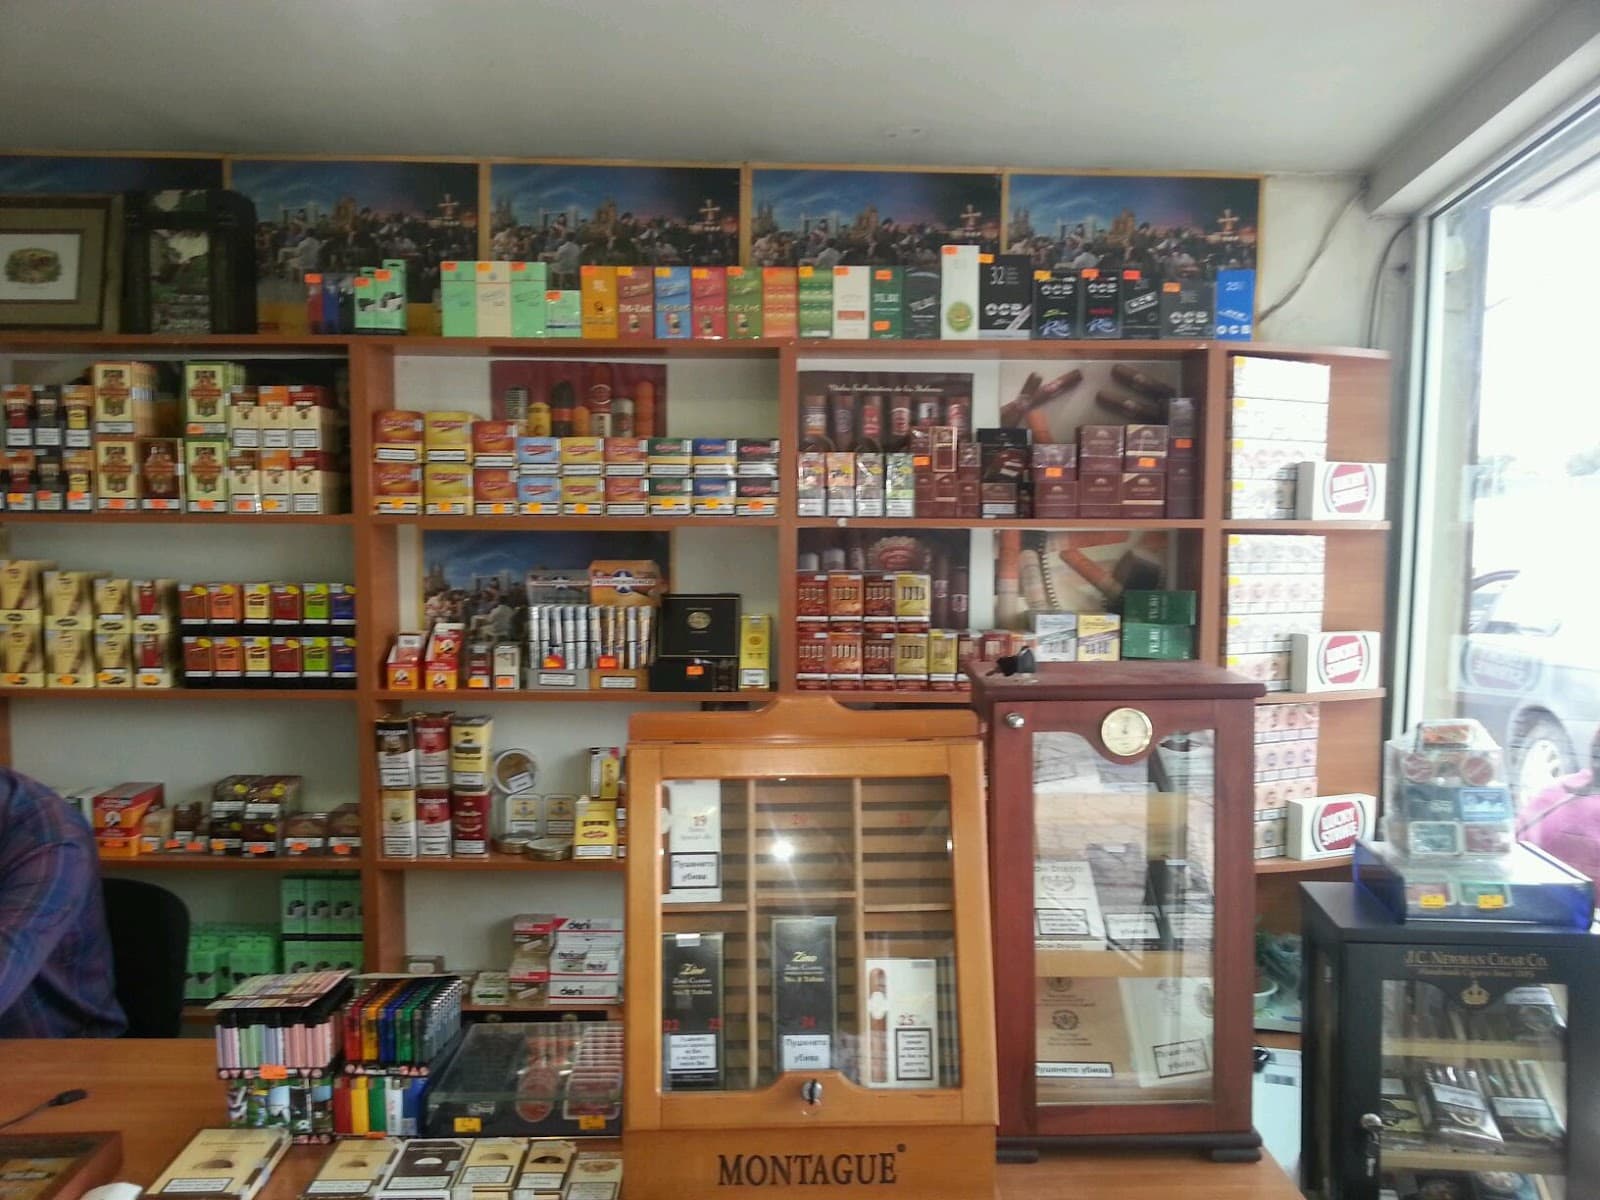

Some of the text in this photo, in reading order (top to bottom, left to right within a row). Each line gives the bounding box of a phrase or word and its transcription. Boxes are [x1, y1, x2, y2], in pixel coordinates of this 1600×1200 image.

[1169, 311, 1208, 324] OCB
[1215, 324, 1252, 335] OCB
[794, 1053, 819, 1064] убива
[717, 1153, 897, 1186] MONTAGUE
